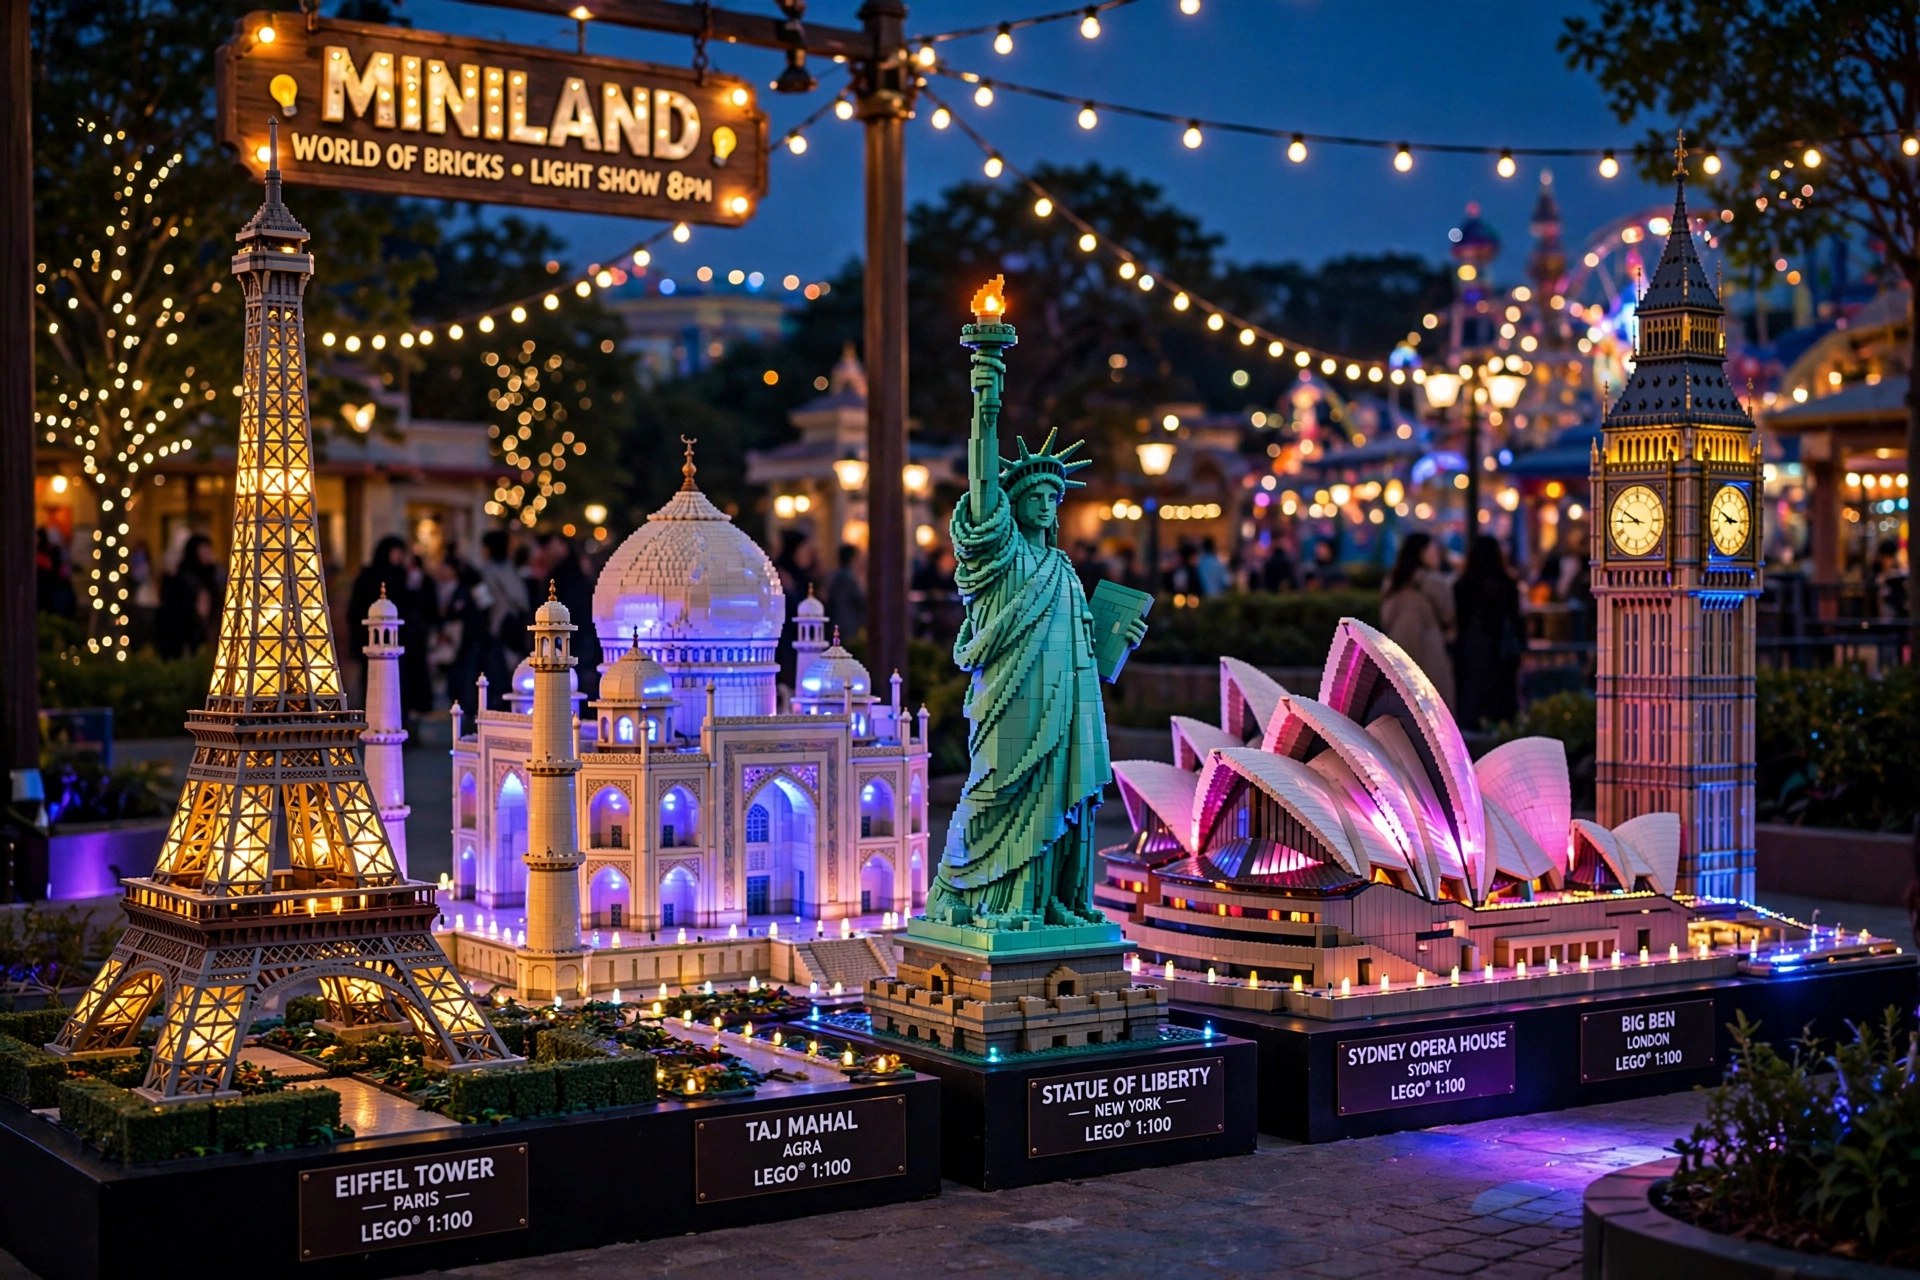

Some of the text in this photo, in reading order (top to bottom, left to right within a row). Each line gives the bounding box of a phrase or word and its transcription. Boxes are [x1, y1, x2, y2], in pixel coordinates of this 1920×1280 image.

[321, 45, 702, 161] MINILAND
[291, 132, 712, 202] WORLD OF BRICKS LIGHT SHOW 8PM
[1622, 1010, 1675, 1032] BIG BEN
[1348, 1030, 1507, 1066] SYDNEY OPERA HOUSE
[1627, 1032, 1670, 1049] LONDON
[1407, 1059, 1452, 1077] SYDNEY
[1615, 1049, 1682, 1071] LEGO® 1:100
[1042, 1066, 1211, 1105] STATUE OF LIBERTY
[1391, 1077, 1466, 1101] LEGO® 1:100
[1094, 1096, 1162, 1118] NEW YORK
[745, 1110, 859, 1142] TAJ MAHAL
[1085, 1116, 1172, 1142] LEGO® 1:100
[782, 1139, 823, 1158] AGRA
[335, 1157, 495, 1198] EIFFEL TOWER
[754, 1158, 851, 1187] LEGO® 1:100
[393, 1190, 440, 1211] PARIS
[361, 1210, 473, 1243] LEGO® 1:100
